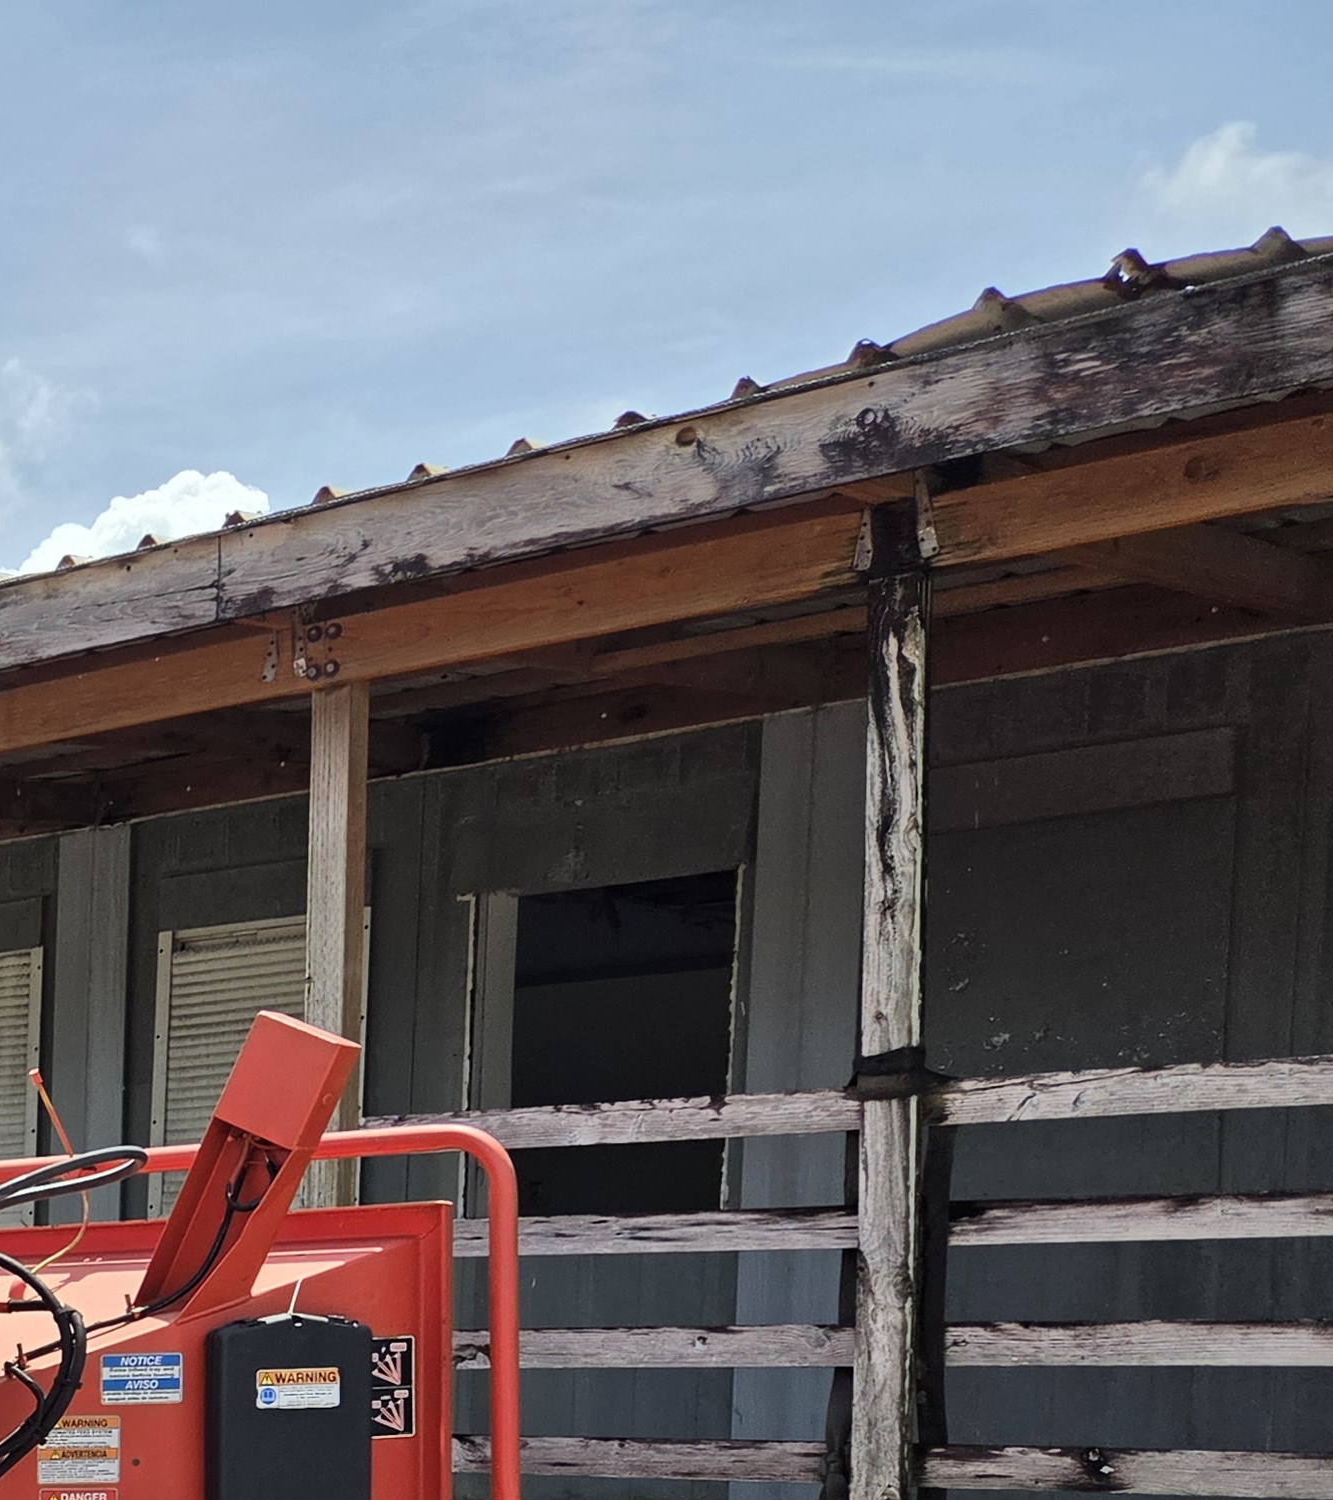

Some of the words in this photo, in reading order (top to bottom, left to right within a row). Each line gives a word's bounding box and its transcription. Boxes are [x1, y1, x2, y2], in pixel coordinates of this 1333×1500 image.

[120, 1355, 163, 1366] NOTICE
[274, 1371, 337, 1384] WARNING
[124, 1379, 159, 1390] AVISO
[61, 1418, 108, 1428] WARNING
[61, 1450, 108, 1459] ADVERTENCIA
